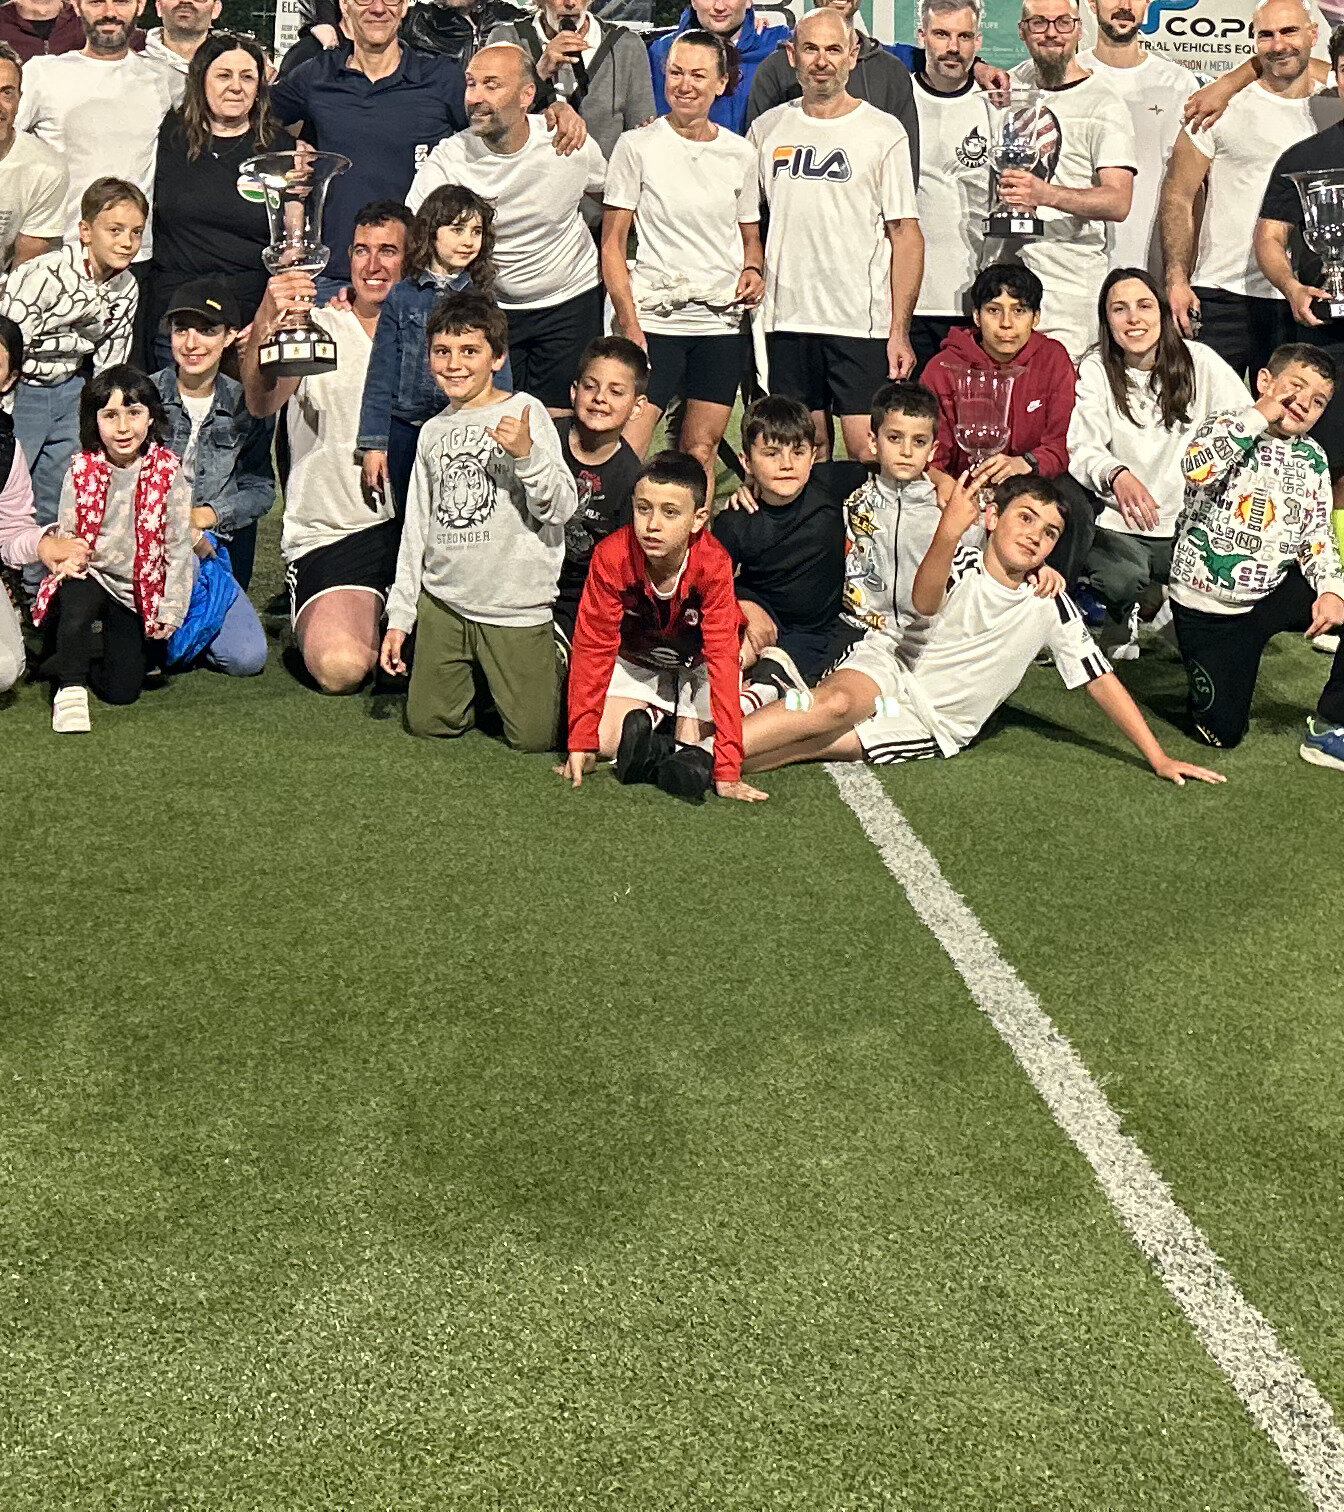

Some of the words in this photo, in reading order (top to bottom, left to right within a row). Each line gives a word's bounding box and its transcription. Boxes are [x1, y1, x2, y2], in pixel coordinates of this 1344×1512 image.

[1174, 42, 1231, 54] VEHICLES
[773, 145, 852, 183] FILA
[1282, 460, 1295, 494] GAME
[1296, 461, 1307, 497] OVER
[437, 531, 491, 545] STRONGER
